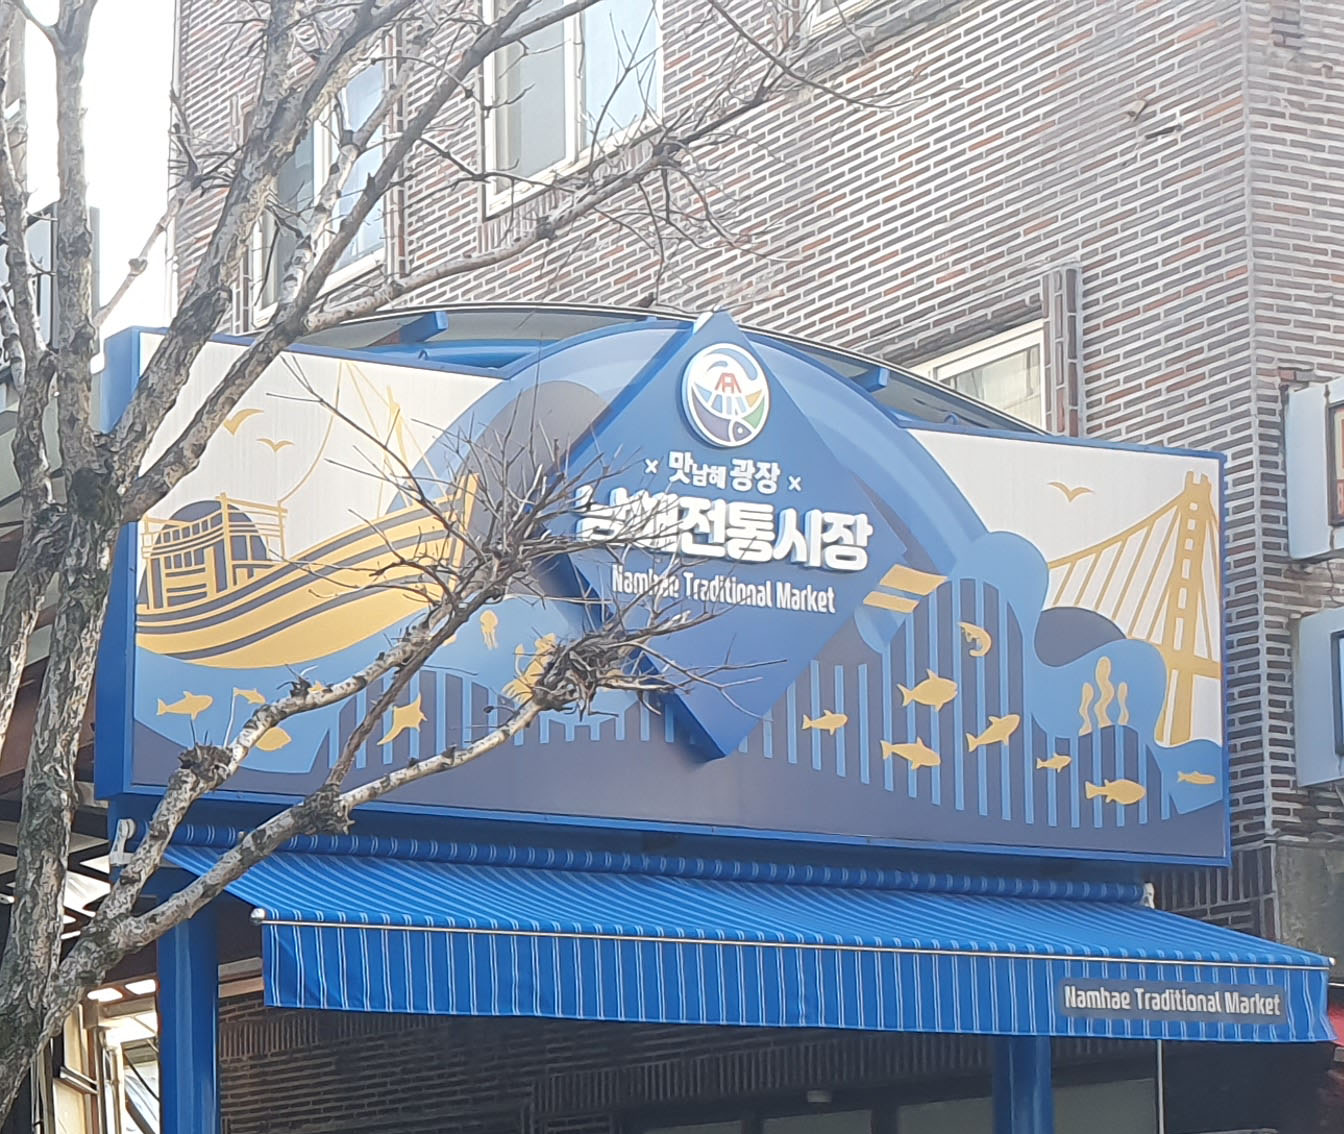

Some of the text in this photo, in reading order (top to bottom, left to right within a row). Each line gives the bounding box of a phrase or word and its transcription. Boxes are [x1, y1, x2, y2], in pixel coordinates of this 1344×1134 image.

[729, 457, 781, 495] 광장
[683, 571, 773, 608] Traditional
[776, 580, 837, 614] Market
[1064, 985, 1281, 1016] Namhae Traditional Market
